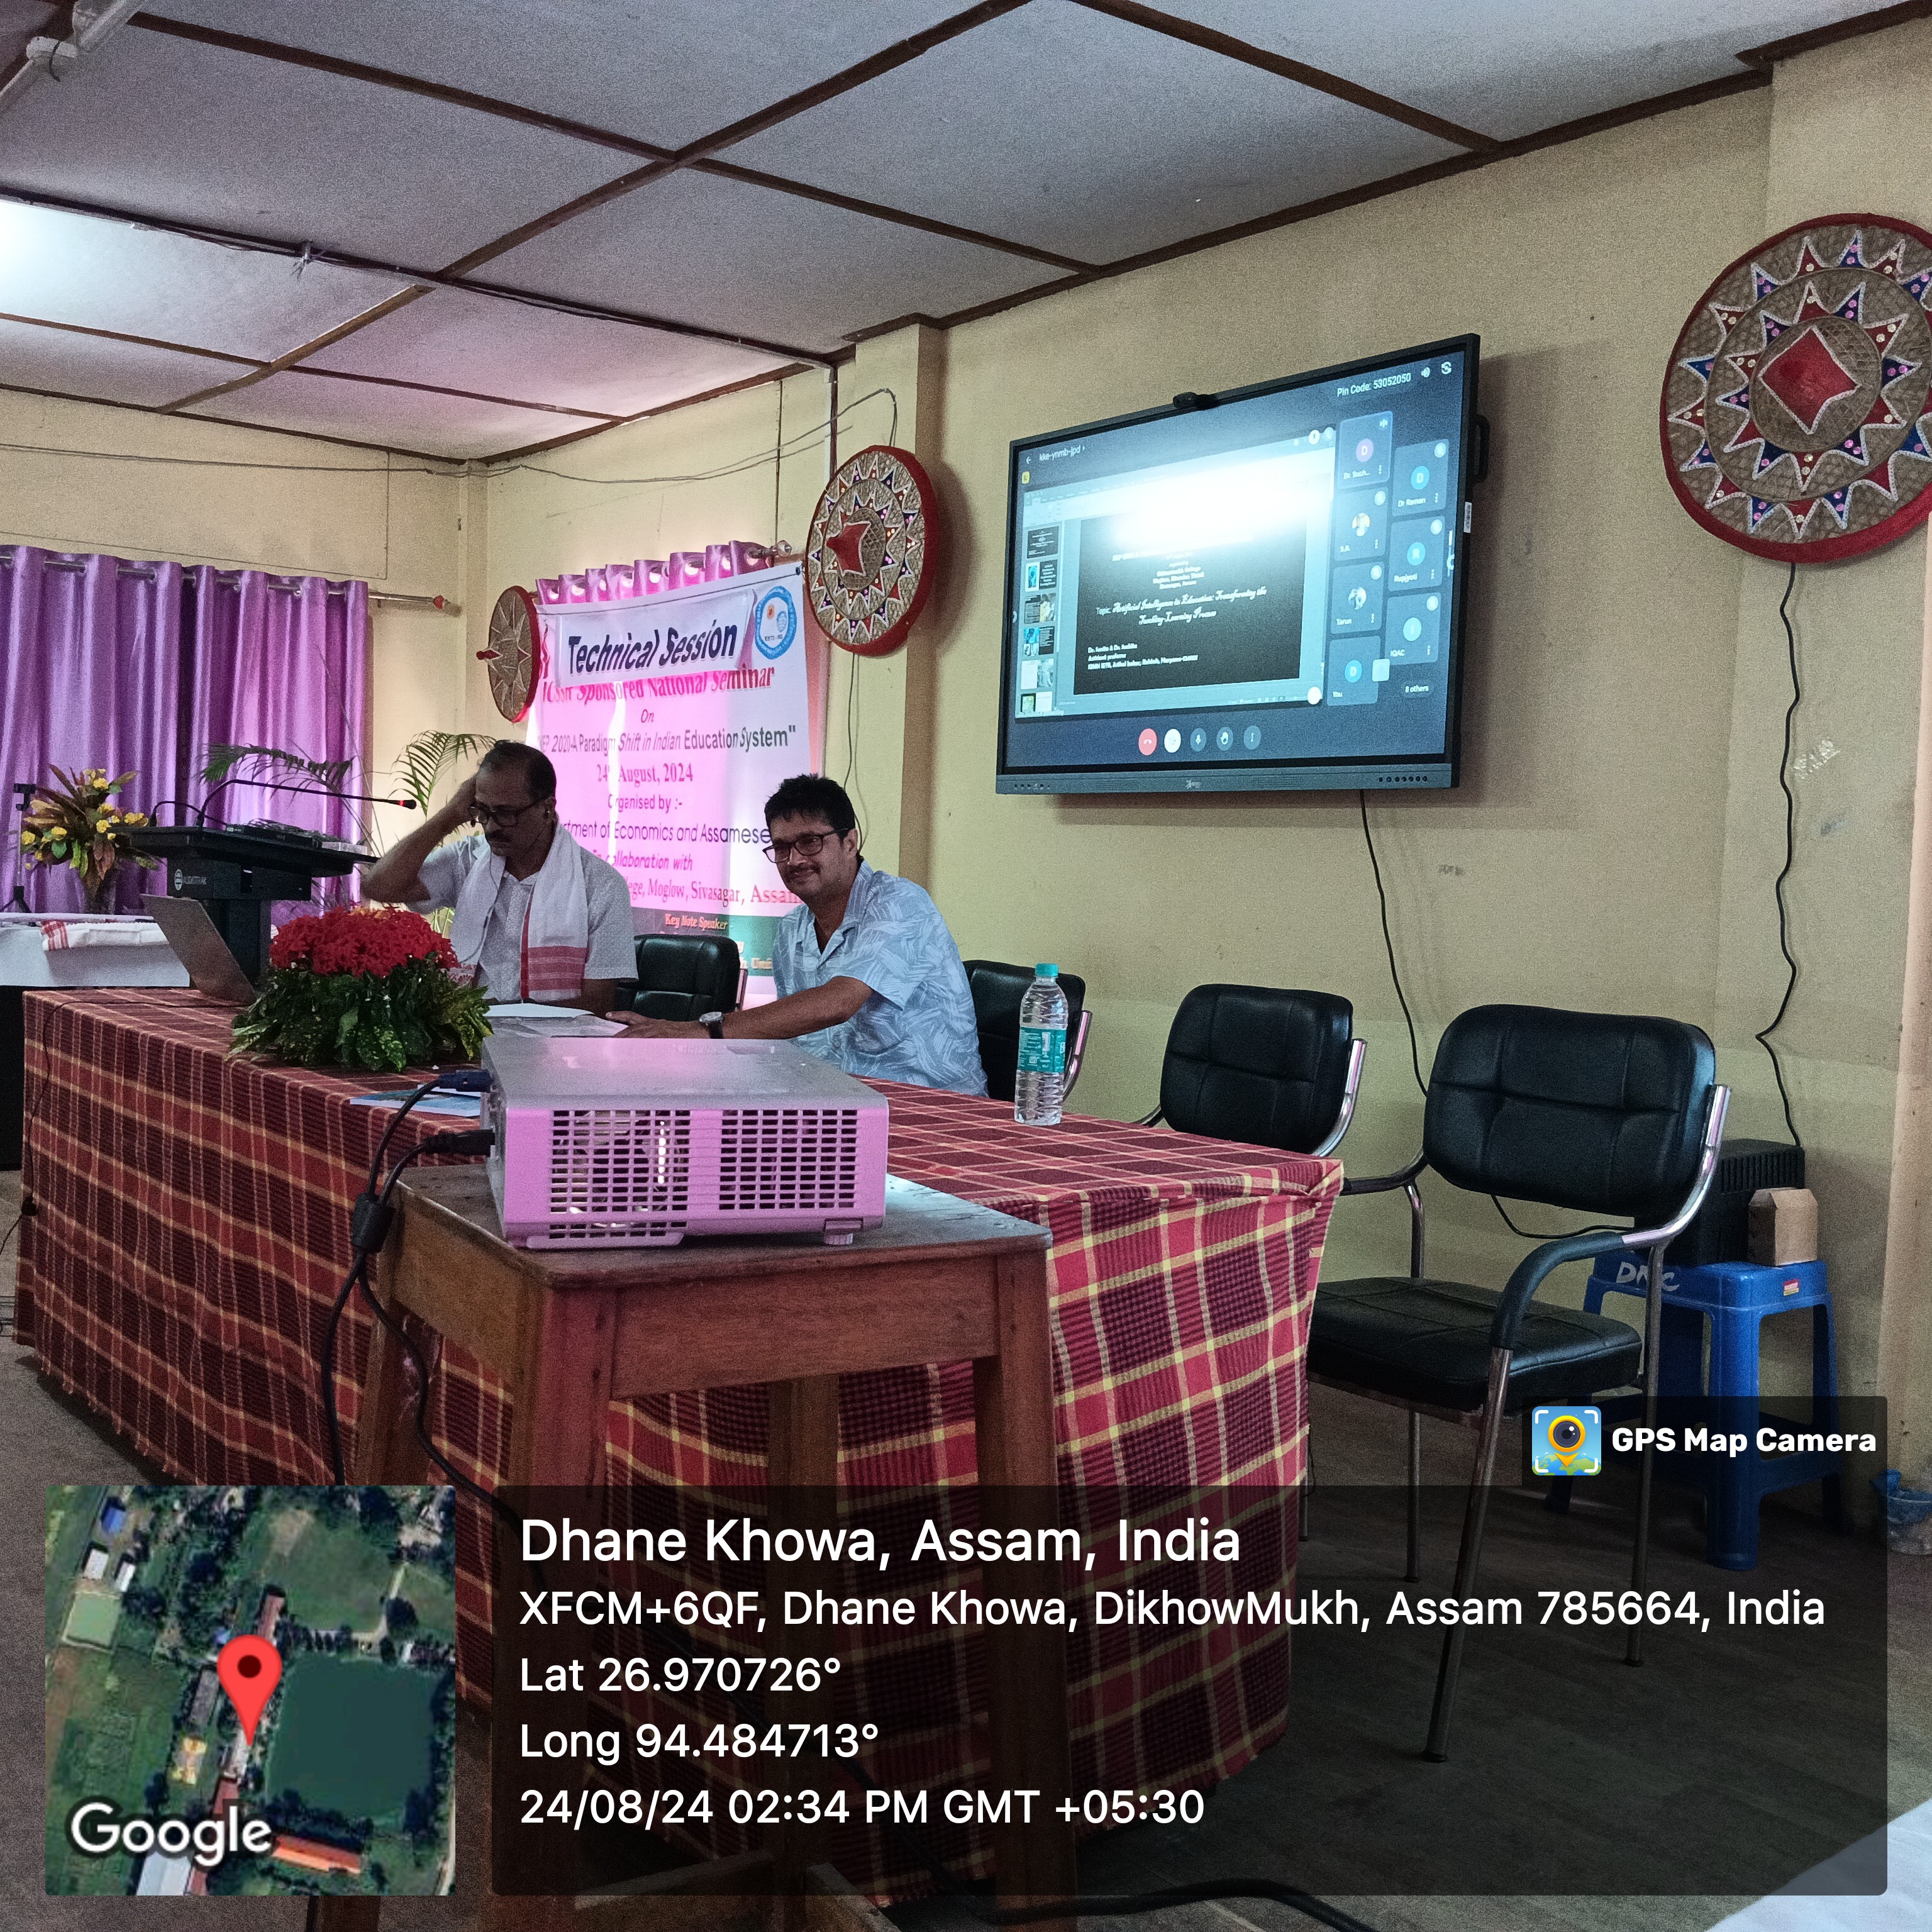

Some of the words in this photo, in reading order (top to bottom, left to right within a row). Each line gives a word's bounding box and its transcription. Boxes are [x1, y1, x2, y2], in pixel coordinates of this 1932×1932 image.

[1337, 387, 1348, 397] Pin
[1374, 373, 1411, 389] 53052050
[1361, 446, 1368, 456] D
[569, 630, 660, 674] Technical
[659, 619, 737, 666] Session
[648, 672, 707, 696] National
[711, 663, 774, 691] Seminar
[641, 709, 654, 723] On
[580, 733, 616, 757] Paradigm
[618, 733, 641, 751] Shift
[642, 733, 651, 751] in
[653, 731, 680, 750] Indian
[684, 728, 738, 750] Education
[618, 765, 660, 787] August,
[663, 763, 693, 782] 2024
[608, 794, 655, 813] Organised
[659, 794, 671, 813] by
[564, 820, 597, 837] rtment
[614, 821, 673, 841] Economics
[677, 823, 698, 842] and
[701, 824, 771, 843] Assamese
[674, 853, 693, 870] with
[691, 881, 745, 908] Sivasagar,
[665, 914, 680, 928] Key
[682, 915, 697, 927] Note
[699, 917, 728, 930] Speaker
